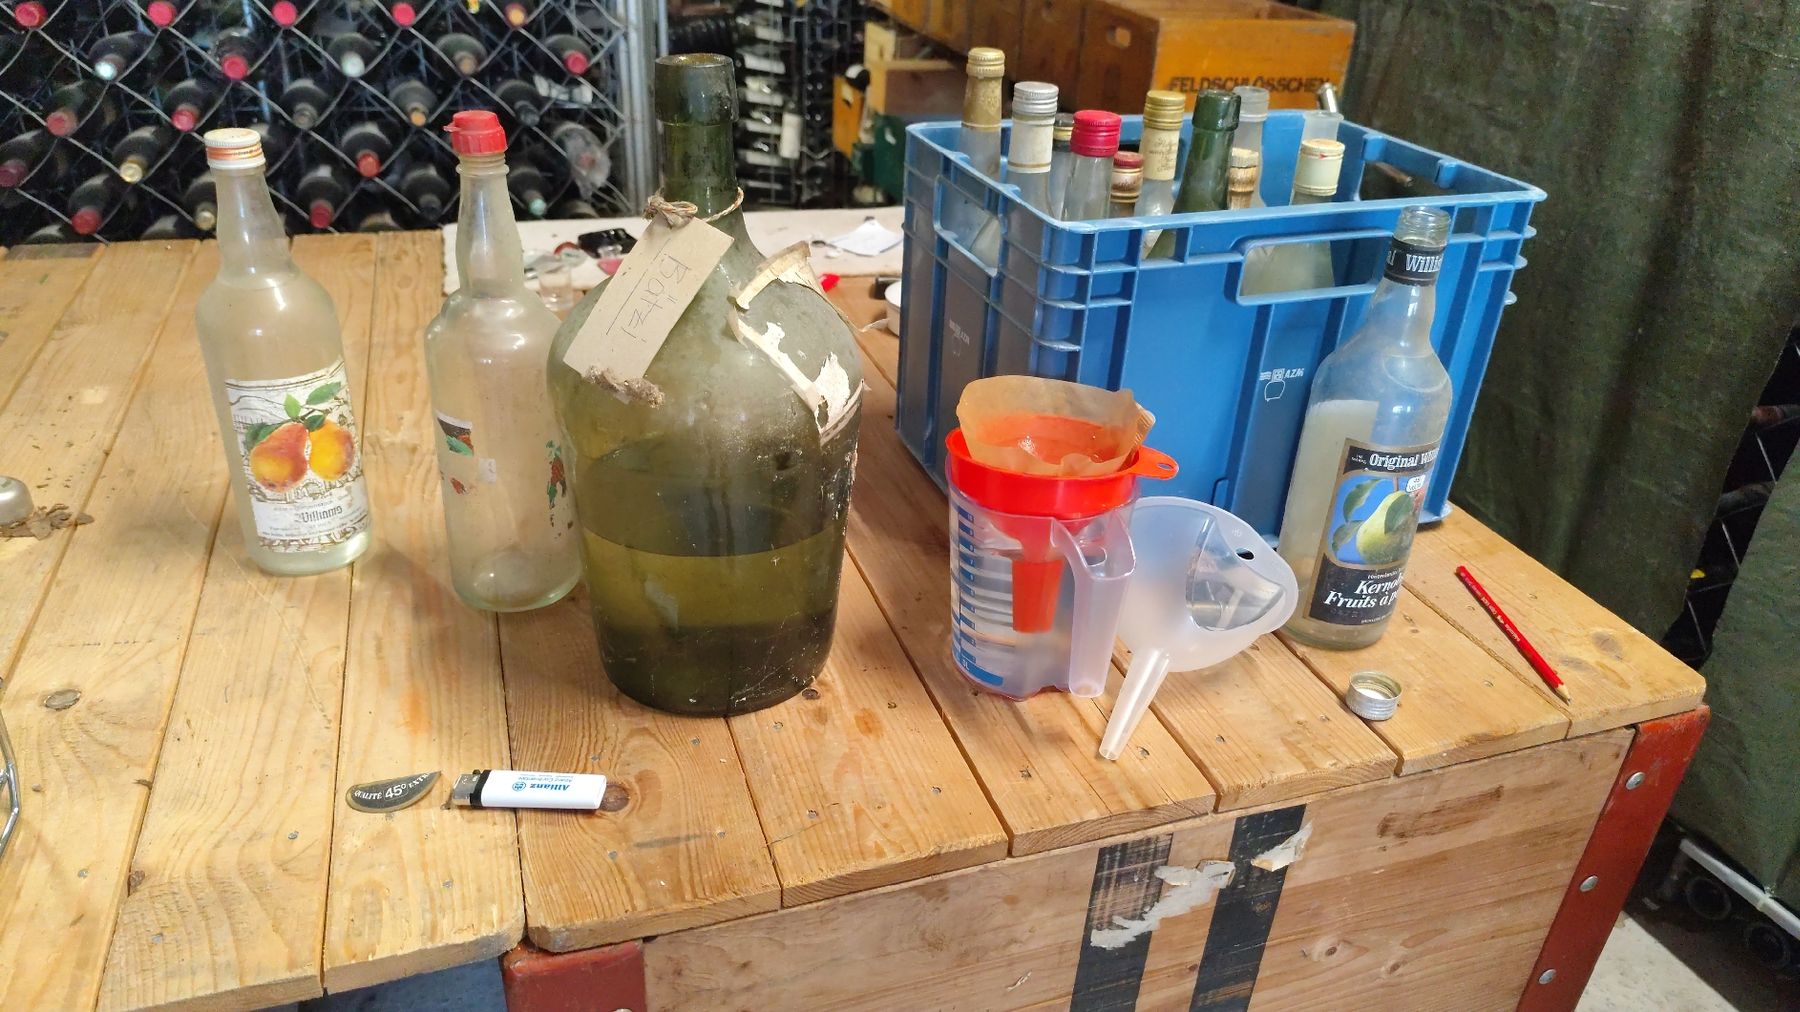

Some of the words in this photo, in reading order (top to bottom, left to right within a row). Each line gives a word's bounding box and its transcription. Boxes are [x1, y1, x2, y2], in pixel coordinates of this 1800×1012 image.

[1369, 453, 1420, 471] Original
[1324, 590, 1378, 608] Fruits
[529, 783, 570, 791] Allianz
